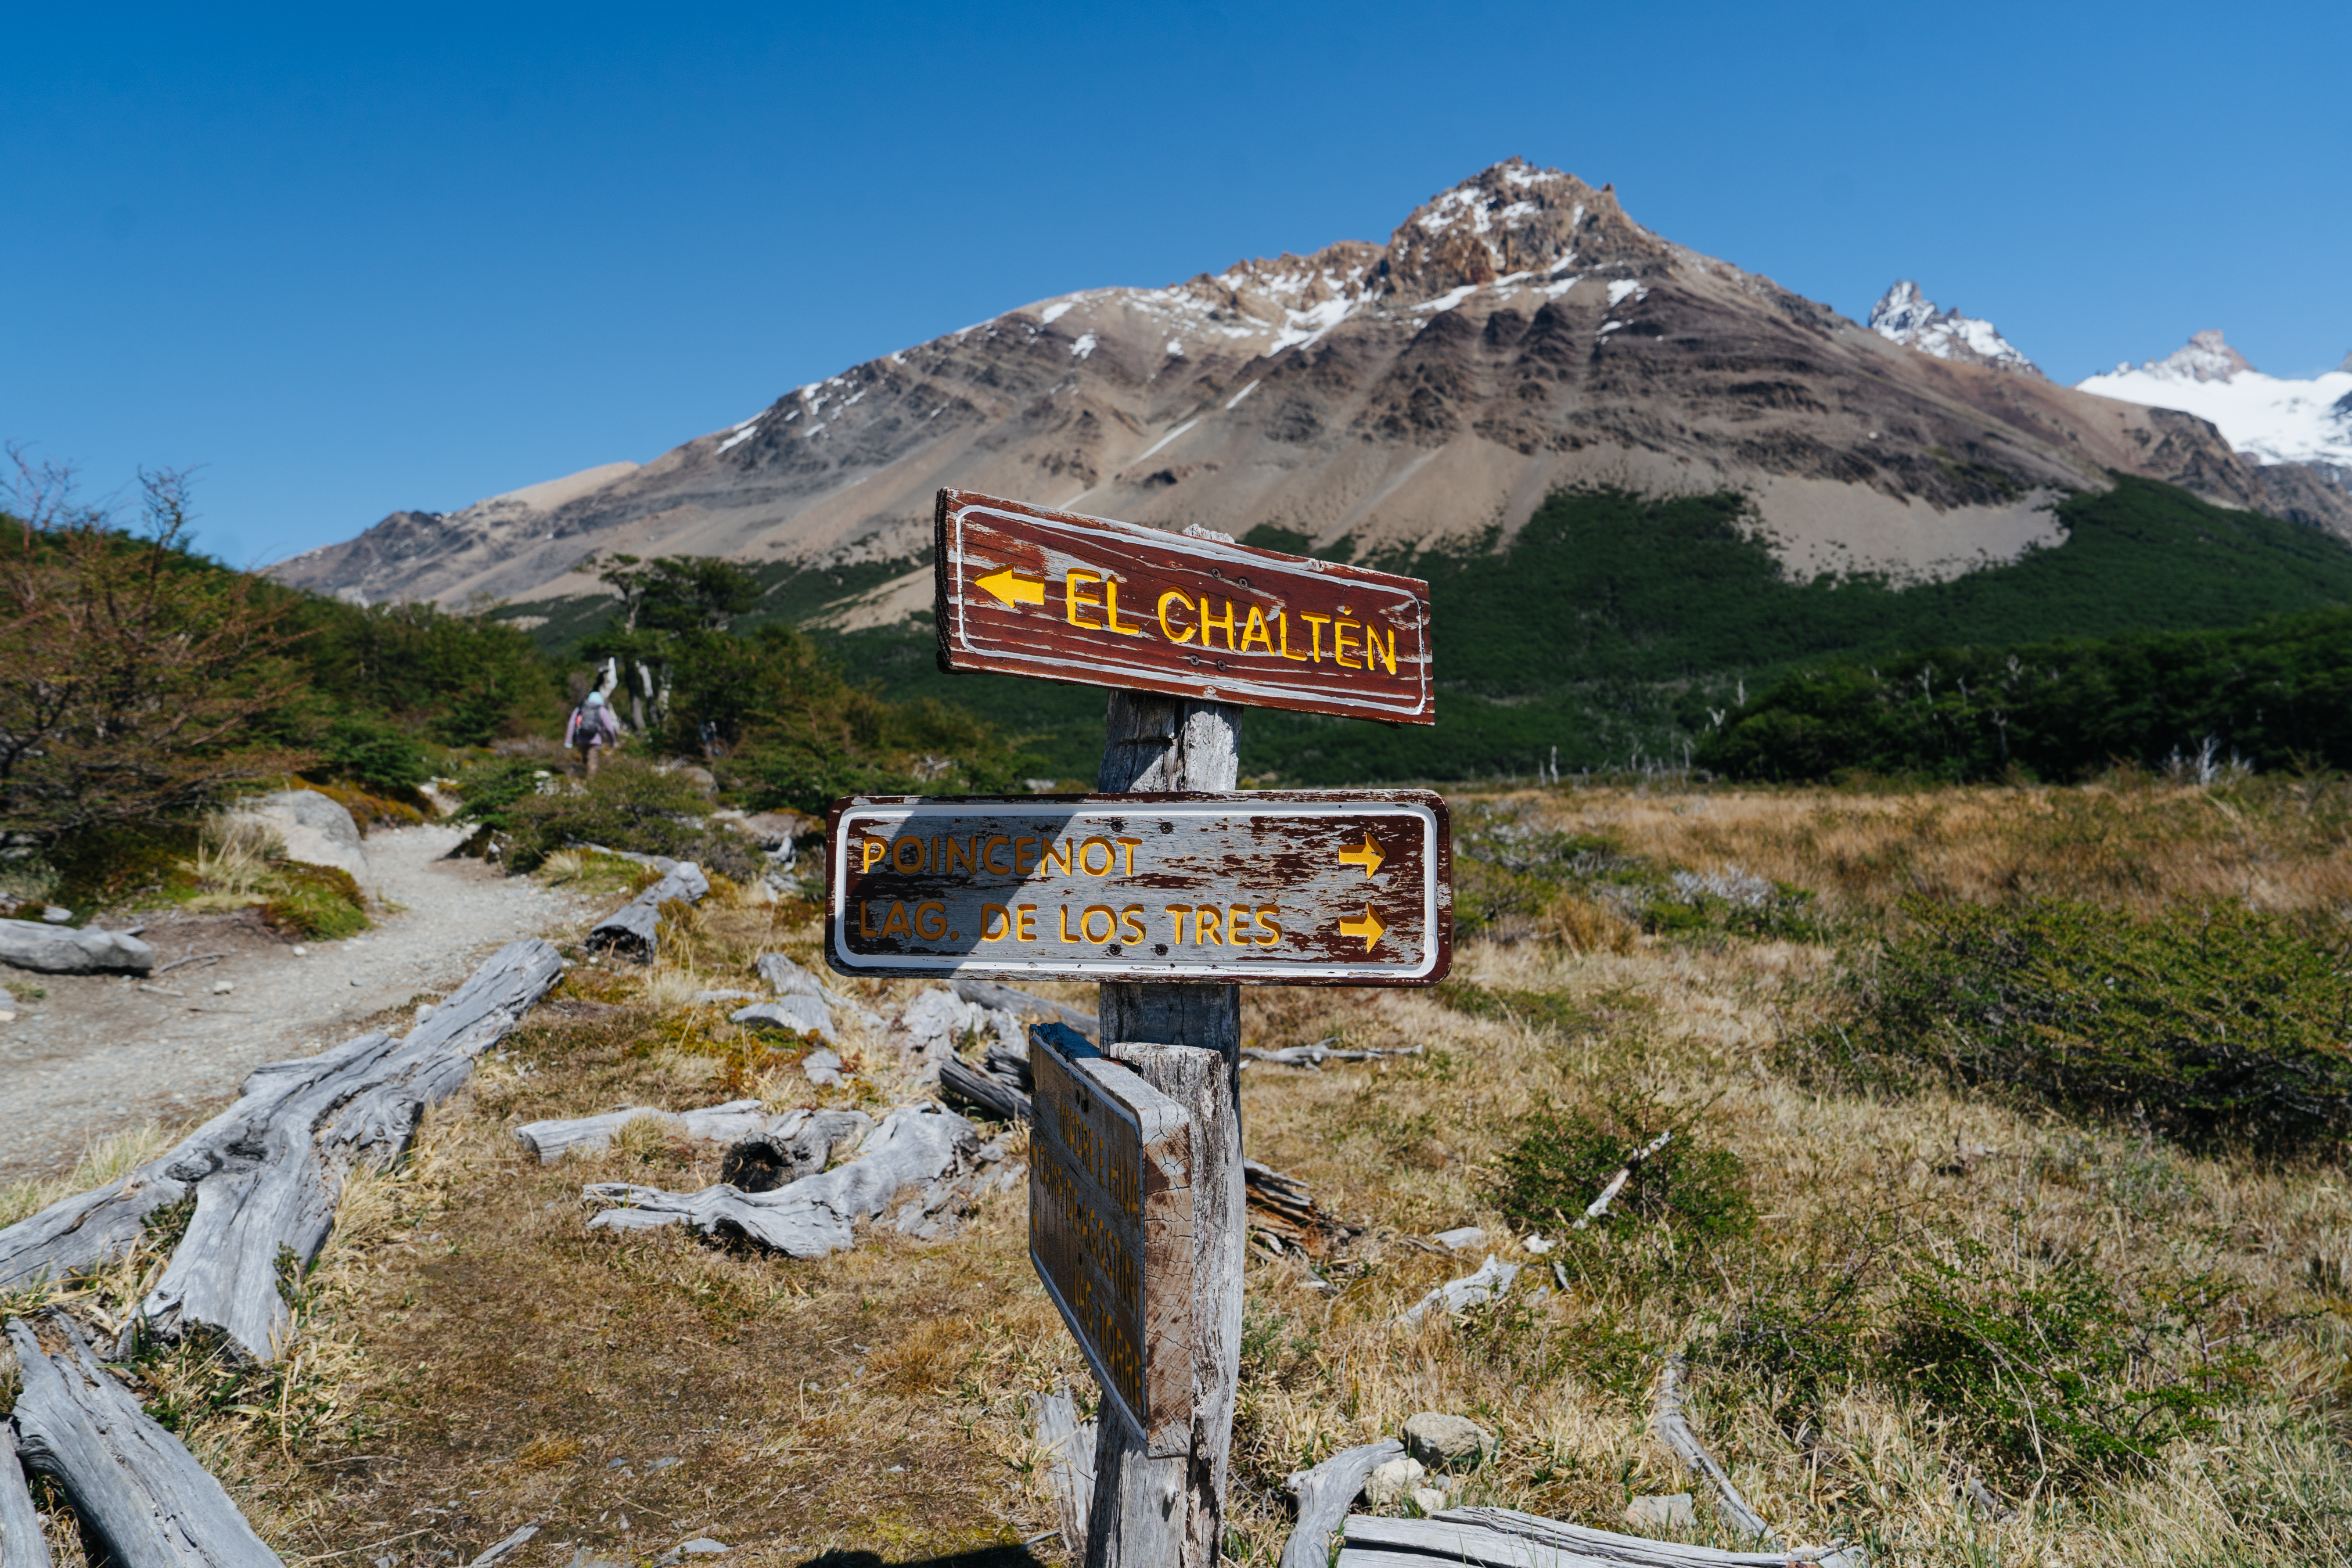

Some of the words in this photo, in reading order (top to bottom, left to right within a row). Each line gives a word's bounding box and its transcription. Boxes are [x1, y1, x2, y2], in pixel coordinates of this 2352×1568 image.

[1066, 568, 1141, 635] EL
[1158, 586, 1396, 675] CHALTÉN
[862, 835, 1143, 877] POINCENOT
[859, 901, 959, 941] LAG.
[980, 903, 1037, 943] DE
[1060, 903, 1146, 946] LOS
[1166, 904, 1282, 947] TRES
[1060, 1099, 1095, 1175] MADRE
[1099, 1138, 1104, 1186] E
[1109, 1145, 1141, 1231] HIJA
[1081, 1200, 1139, 1317] AGOSTINI
[1099, 1301, 1142, 1411] TORRE
